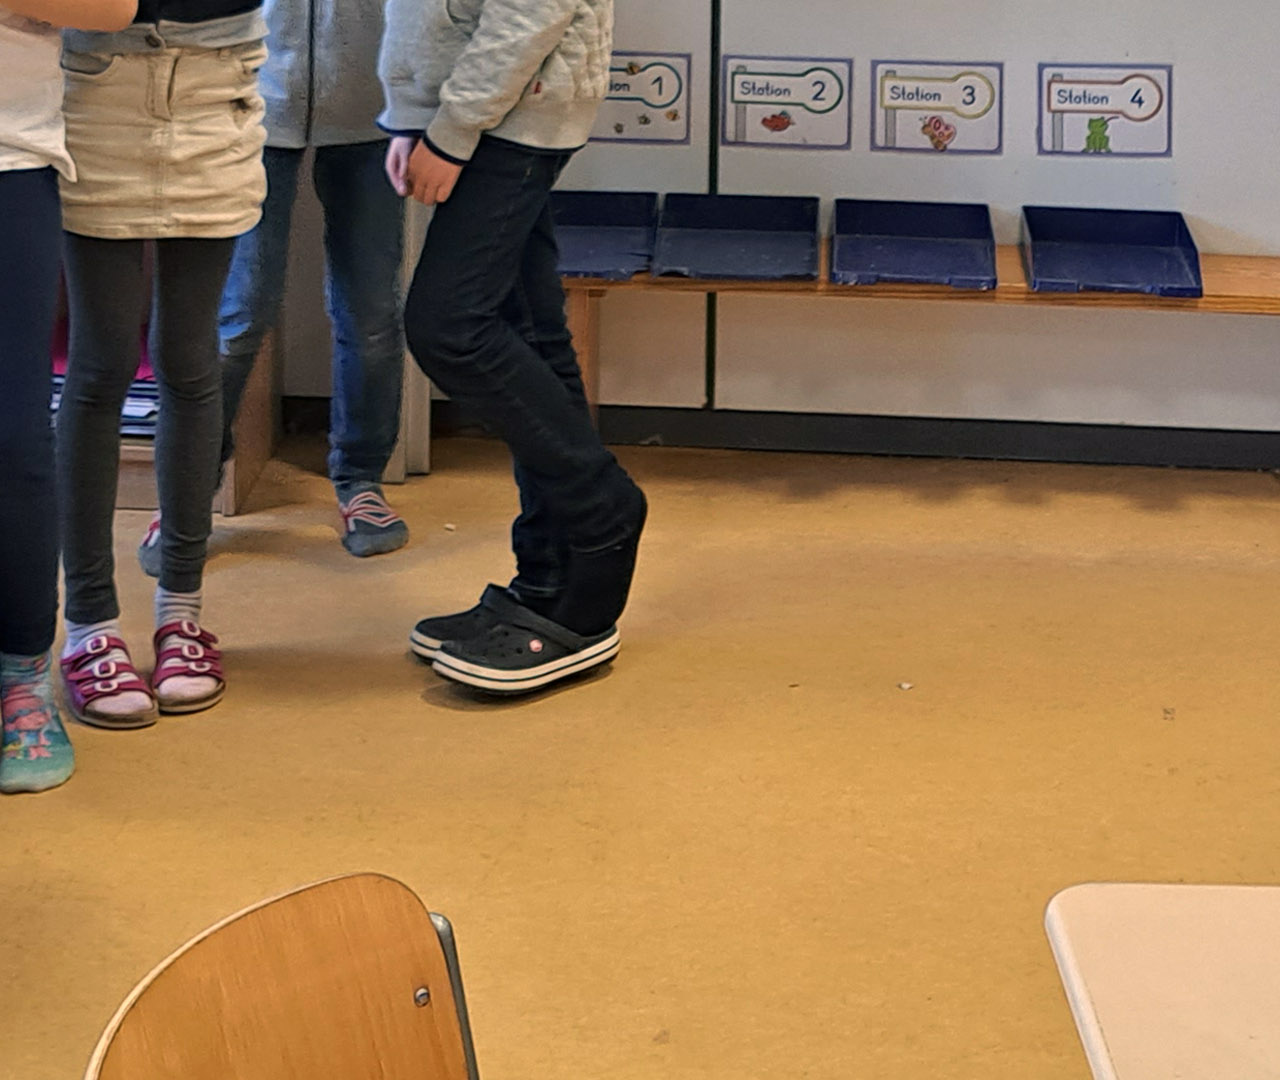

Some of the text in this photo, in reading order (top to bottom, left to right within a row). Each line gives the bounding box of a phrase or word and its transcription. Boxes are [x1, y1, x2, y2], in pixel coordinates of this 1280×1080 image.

[739, 80, 826, 102] Station 2
[889, 84, 977, 107] Station 3
[1055, 87, 1146, 109] Station 4
